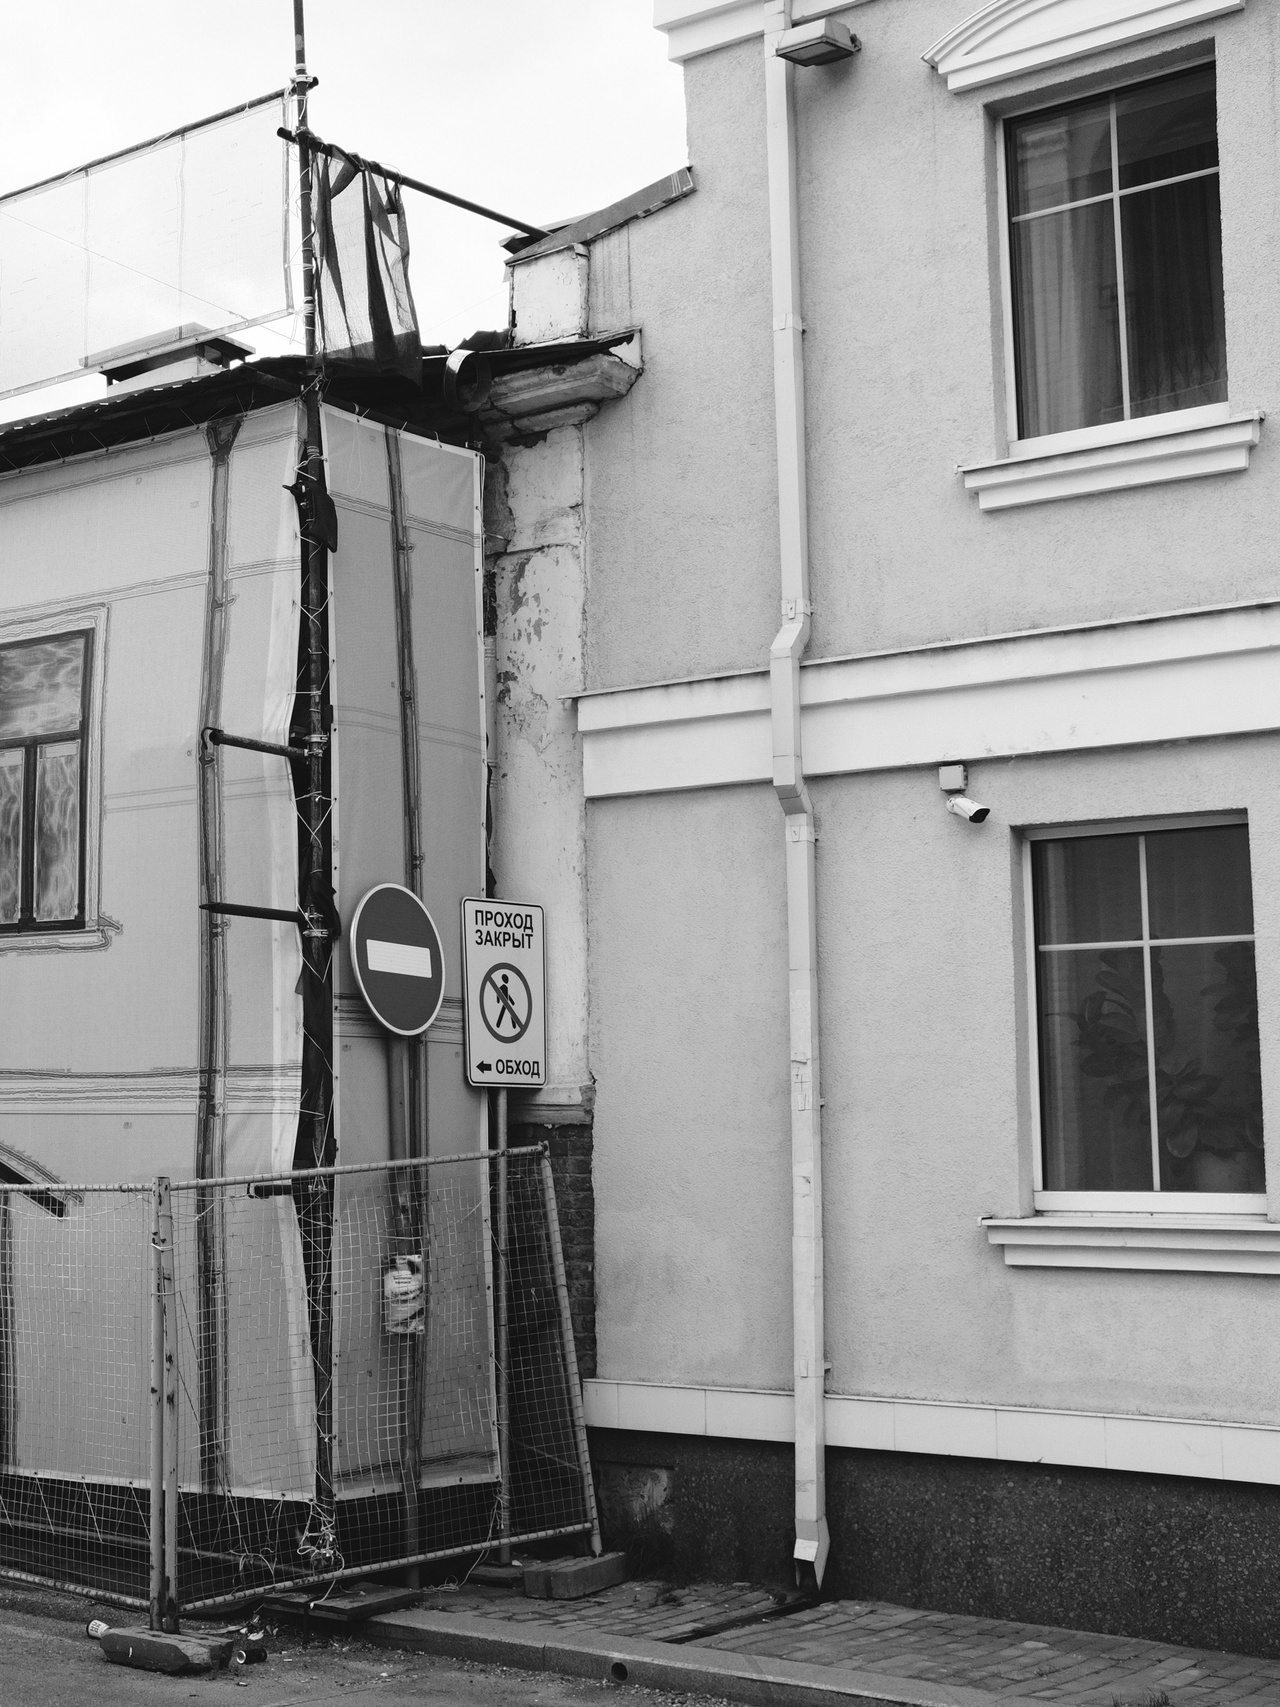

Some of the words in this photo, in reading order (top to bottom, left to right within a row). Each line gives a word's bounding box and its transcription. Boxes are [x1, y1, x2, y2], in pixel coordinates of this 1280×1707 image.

[474, 909, 534, 933] ПРОХОД
[474, 929, 534, 949] ЗАКРЫТ
[495, 1058, 541, 1079] ОБХОД
